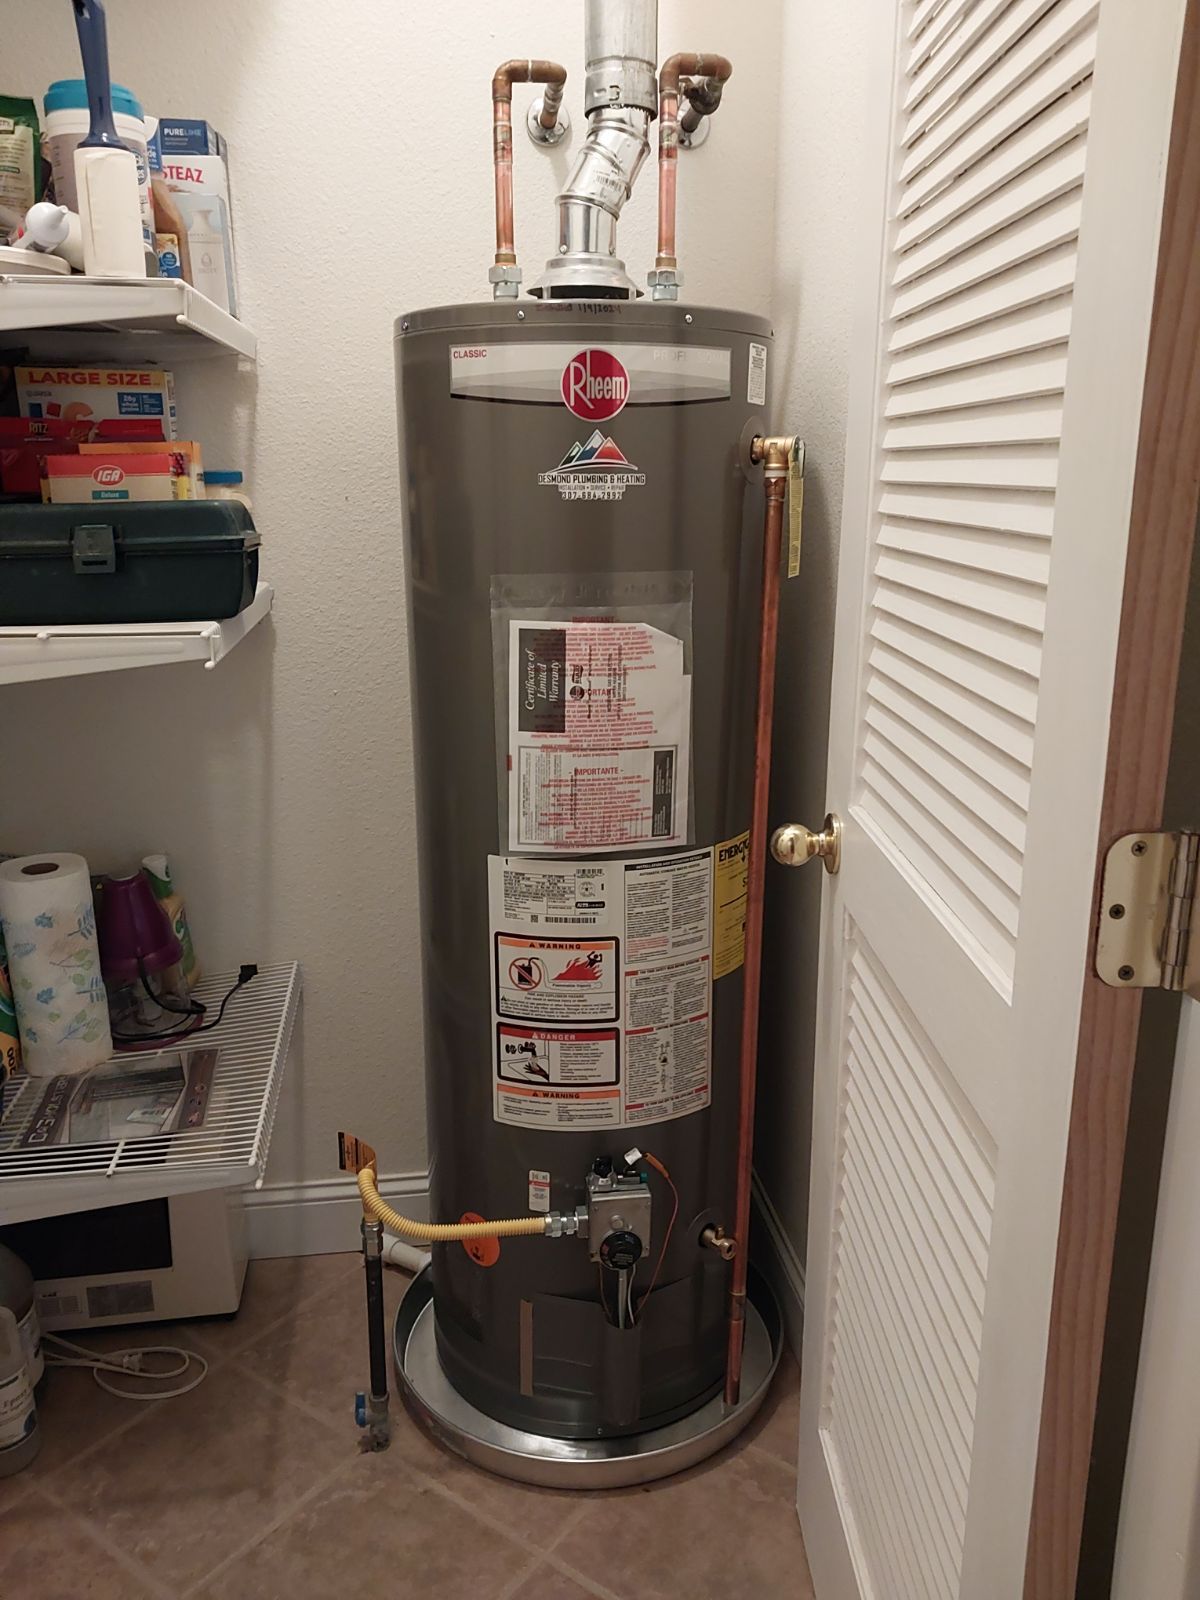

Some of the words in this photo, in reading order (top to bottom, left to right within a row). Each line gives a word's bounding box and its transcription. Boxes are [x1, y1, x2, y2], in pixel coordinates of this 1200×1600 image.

[453, 349, 487, 359] CLASSIC
[28, 371, 101, 385] LARGE
[107, 373, 152, 386] SIZE
[570, 350, 625, 409] Rheem
[29, 422, 49, 433] RITZ
[97, 470, 122, 482] IGA
[539, 474, 571, 484] DESMOND
[573, 474, 608, 484] PLUMBING
[609, 474, 615, 484] &
[616, 474, 645, 484] HEATING
[525, 648, 535, 661] of
[525, 662, 535, 710] Certificate
[537, 663, 547, 699] Limited
[548, 660, 561, 702] Warranty
[538, 942, 581, 950] WARNING
